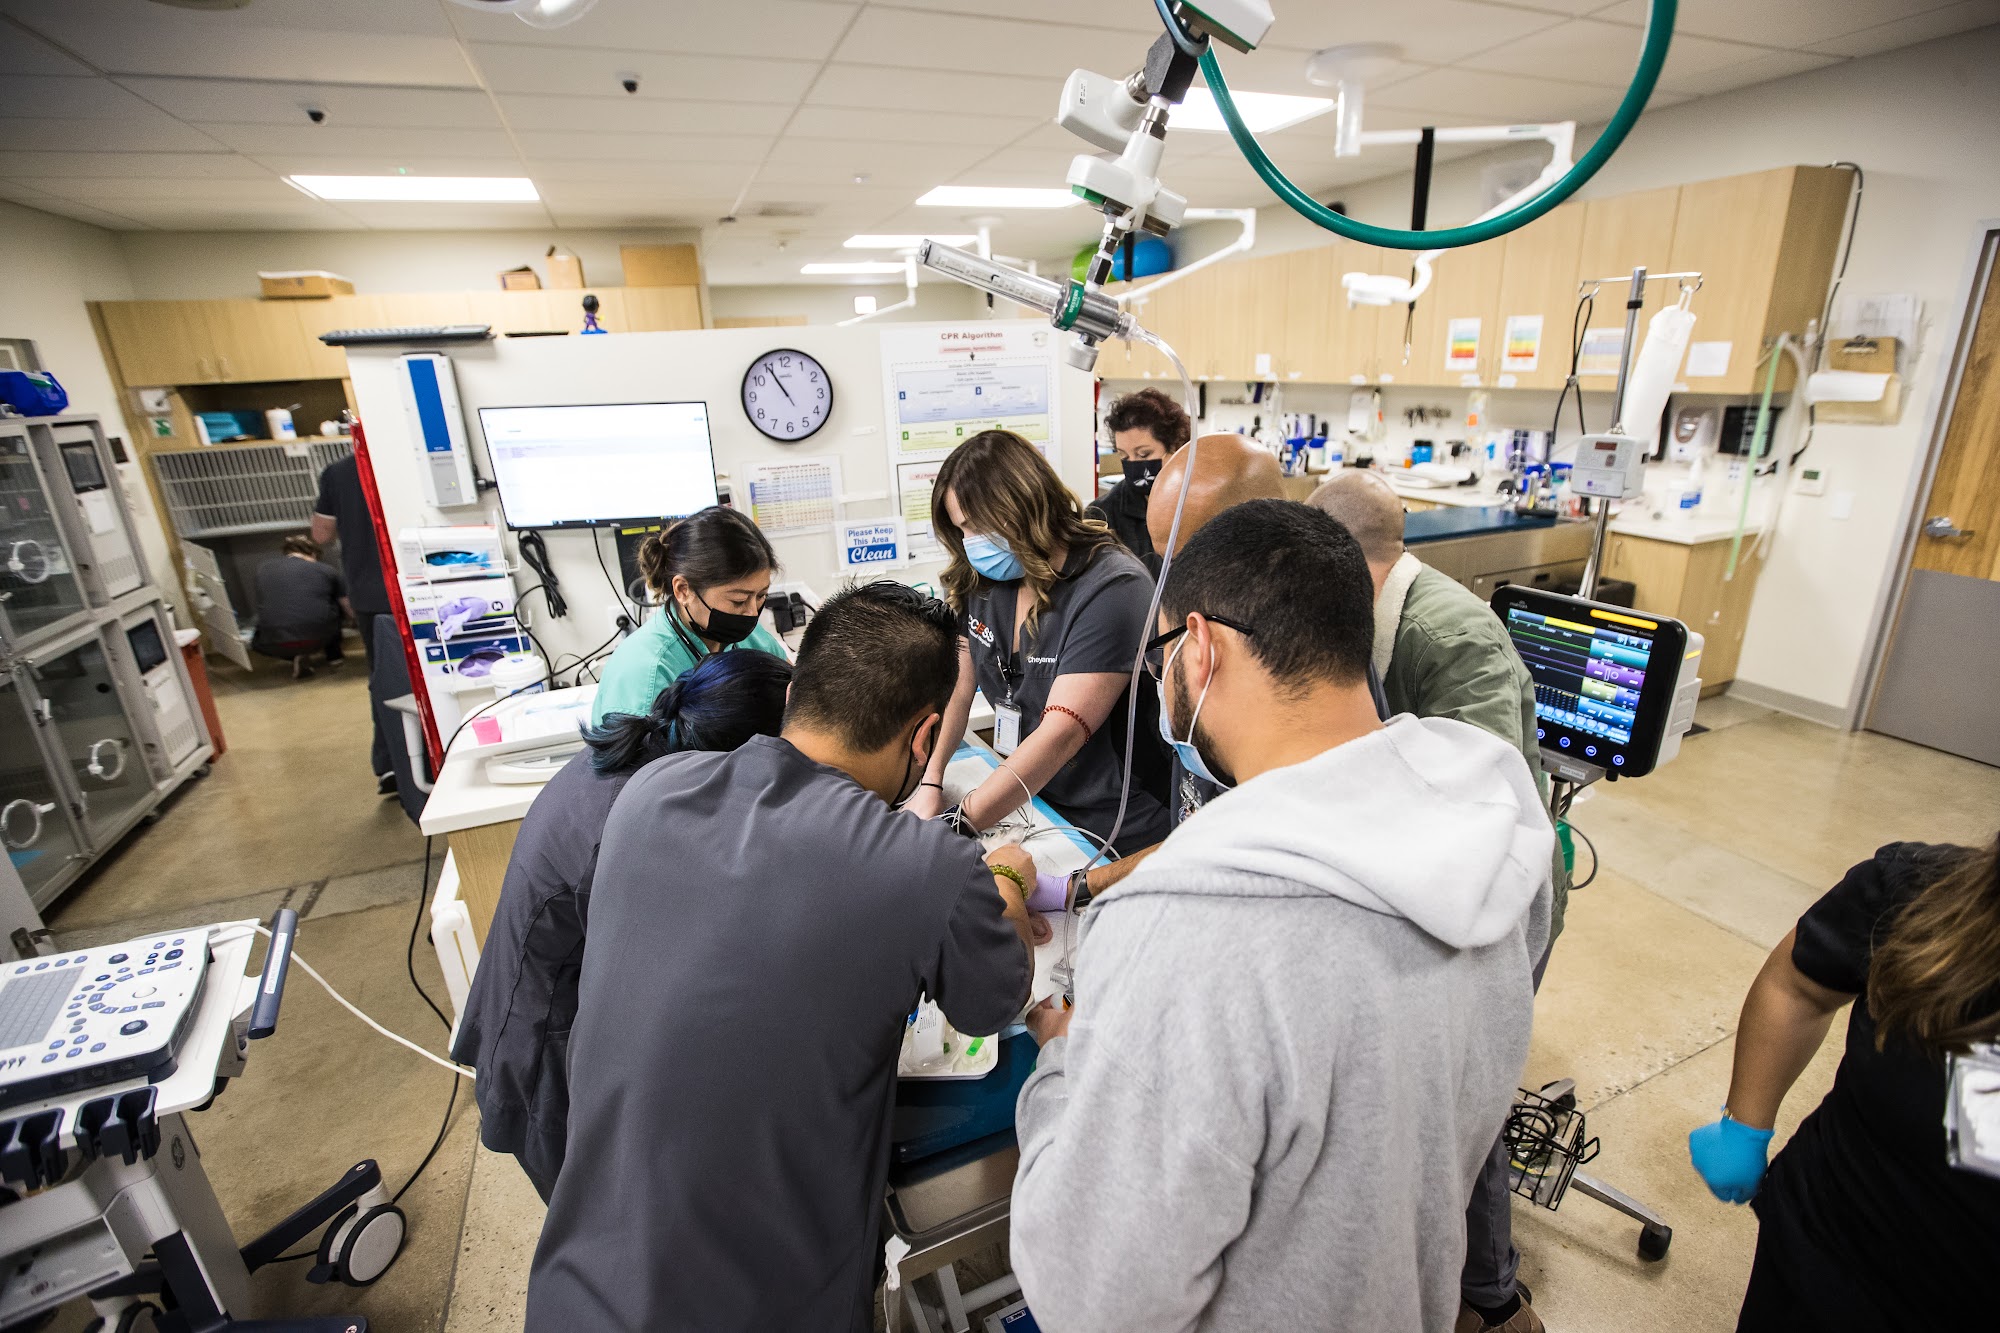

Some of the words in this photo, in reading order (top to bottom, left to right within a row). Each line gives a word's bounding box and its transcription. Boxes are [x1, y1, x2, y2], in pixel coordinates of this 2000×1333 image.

[941, 332, 959, 340] CPR
[961, 332, 1003, 341] Algorithm
[779, 356, 791, 367] 12
[799, 361, 804, 371] 1
[753, 375, 765, 387] 10
[810, 371, 818, 383] 2
[749, 391, 757, 402] 9
[816, 388, 824, 399] 3
[757, 408, 765, 419] 8
[813, 405, 820, 415] 4
[770, 419, 778, 430] 7
[786, 422, 794, 433] 6
[802, 417, 809, 428] 5
[848, 529, 873, 537] Please
[874, 527, 893, 535] Keep
[851, 546, 893, 563] Clean
